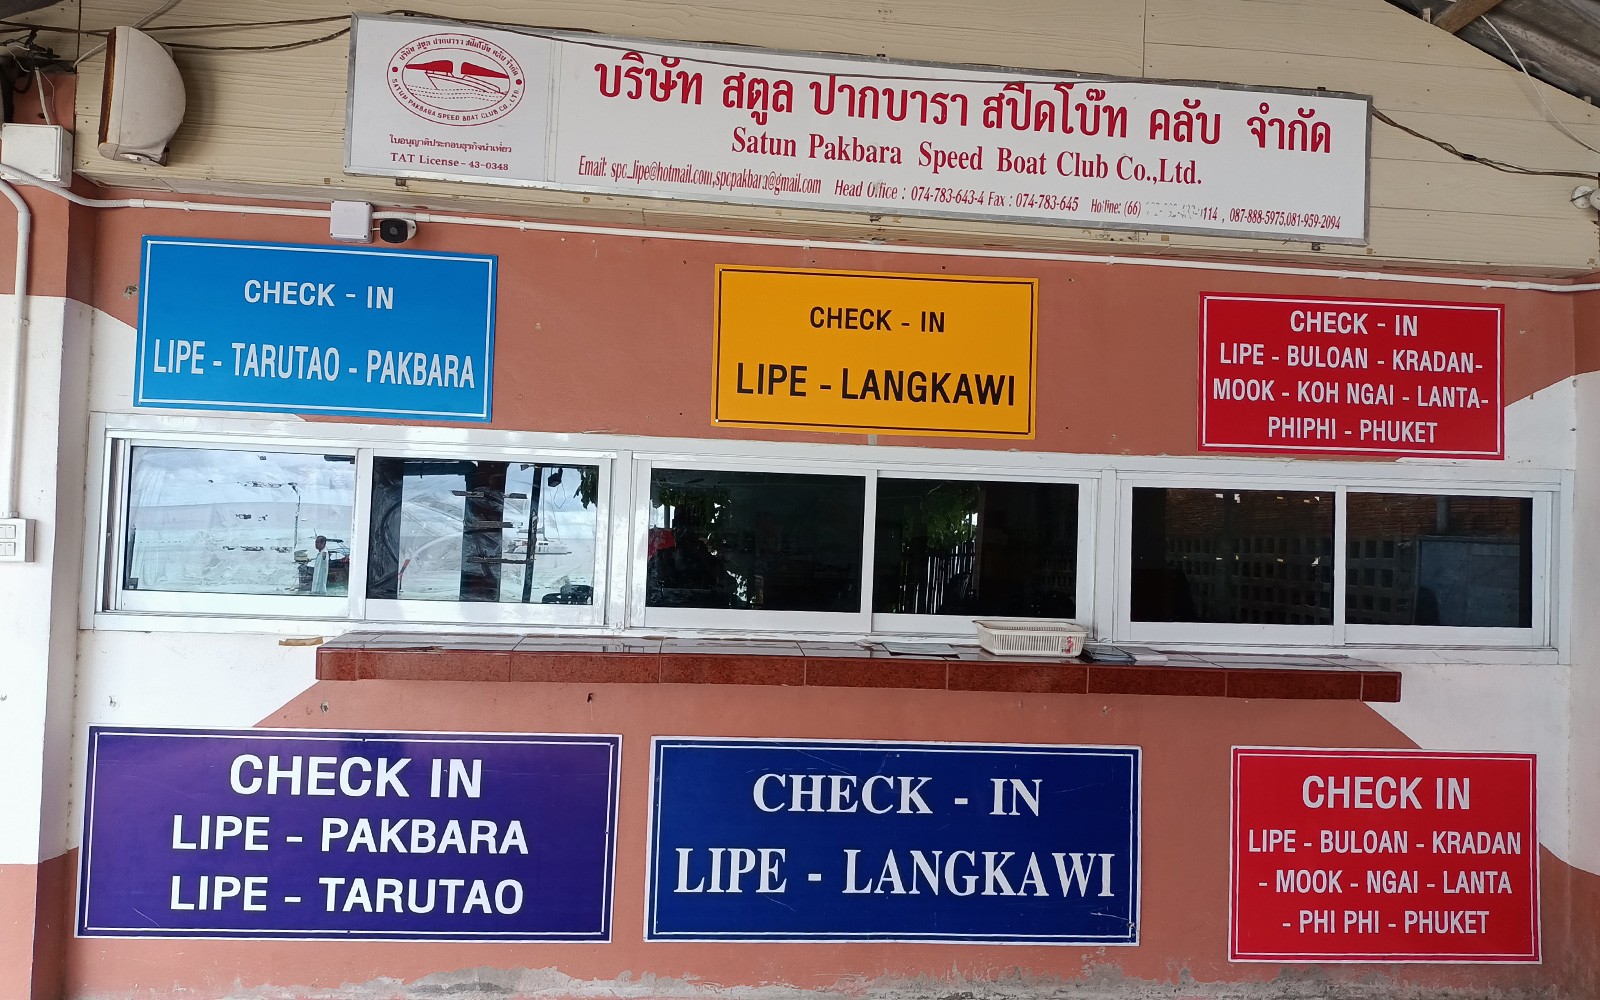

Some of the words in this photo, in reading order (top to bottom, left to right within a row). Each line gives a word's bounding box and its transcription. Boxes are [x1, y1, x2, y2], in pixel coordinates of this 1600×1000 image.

[392, 78, 409, 100] SATUN
[408, 99, 436, 116] PAKBARA
[437, 112, 460, 121] SPEED
[462, 114, 479, 122] BOAT
[480, 109, 499, 119] CLUB
[594, 51, 703, 106] บริษัท
[722, 71, 794, 126] สตูล
[808, 74, 968, 127] ปากบารา
[982, 81, 1128, 139] สปีดโบ๊ท
[1148, 98, 1221, 145] คลับ
[1246, 102, 1332, 154] จำกัด
[390, 152, 416, 163] TAT
[731, 126, 797, 157] Satun
[808, 133, 903, 165] Pakbara
[917, 141, 984, 175] Speed
[996, 147, 1048, 175] Boat
[1056, 151, 1109, 180] Club
[1115, 155, 1203, 185] Co.,Ltd.
[578, 155, 608, 177] Email:
[834, 179, 864, 197] Head
[911, 185, 985, 206] 074-783-643-4
[987, 191, 1005, 207] Fax
[1015, 192, 1080, 212] 074-783-645
[1123, 201, 1142, 218] (66)
[244, 279, 336, 307] CHECK
[367, 285, 394, 310] IN
[809, 306, 893, 332] CHECK
[920, 311, 945, 333] IN
[1290, 310, 1369, 335] CHECK
[1394, 314, 1419, 337] IN
[153, 338, 206, 375] LIPE
[231, 342, 340, 382] TARUTAO
[366, 349, 476, 389] PAKBARA
[1219, 342, 1265, 366] LIPE
[1287, 345, 1368, 370] BULOAN
[736, 362, 808, 398] LIPE
[841, 367, 1015, 406] LANGKAWI
[1213, 377, 1275, 402] MOOK
[1297, 380, 1339, 404] KOH
[1346, 382, 1395, 406] NGAI
[1268, 416, 1337, 440] PHIPHI
[1360, 419, 1438, 444] PHUKET
[229, 753, 413, 798] CHECK
[430, 758, 482, 799] IN
[1302, 775, 1423, 810] CHECK
[1436, 777, 1470, 811] IN
[752, 773, 933, 815] CHECK
[989, 778, 1043, 818] IN
[171, 814, 270, 851] LIPE
[321, 817, 529, 856] PAKBARA
[1249, 828, 1296, 853] LIPE
[1320, 829, 1408, 854] BULOAN
[1432, 830, 1521, 855] KRADAN
[673, 847, 788, 894] LIPE
[842, 849, 1115, 898] LANGKAWI
[1275, 869, 1343, 894] MOOK
[1366, 869, 1419, 894] NGAI
[1443, 870, 1513, 894] LANTA
[170, 875, 268, 912] LIPE
[318, 876, 524, 916] TARUTAO
[1299, 909, 1336, 934] PHI
[1343, 909, 1380, 934] PHI
[1404, 909, 1490, 935] PHUKET
